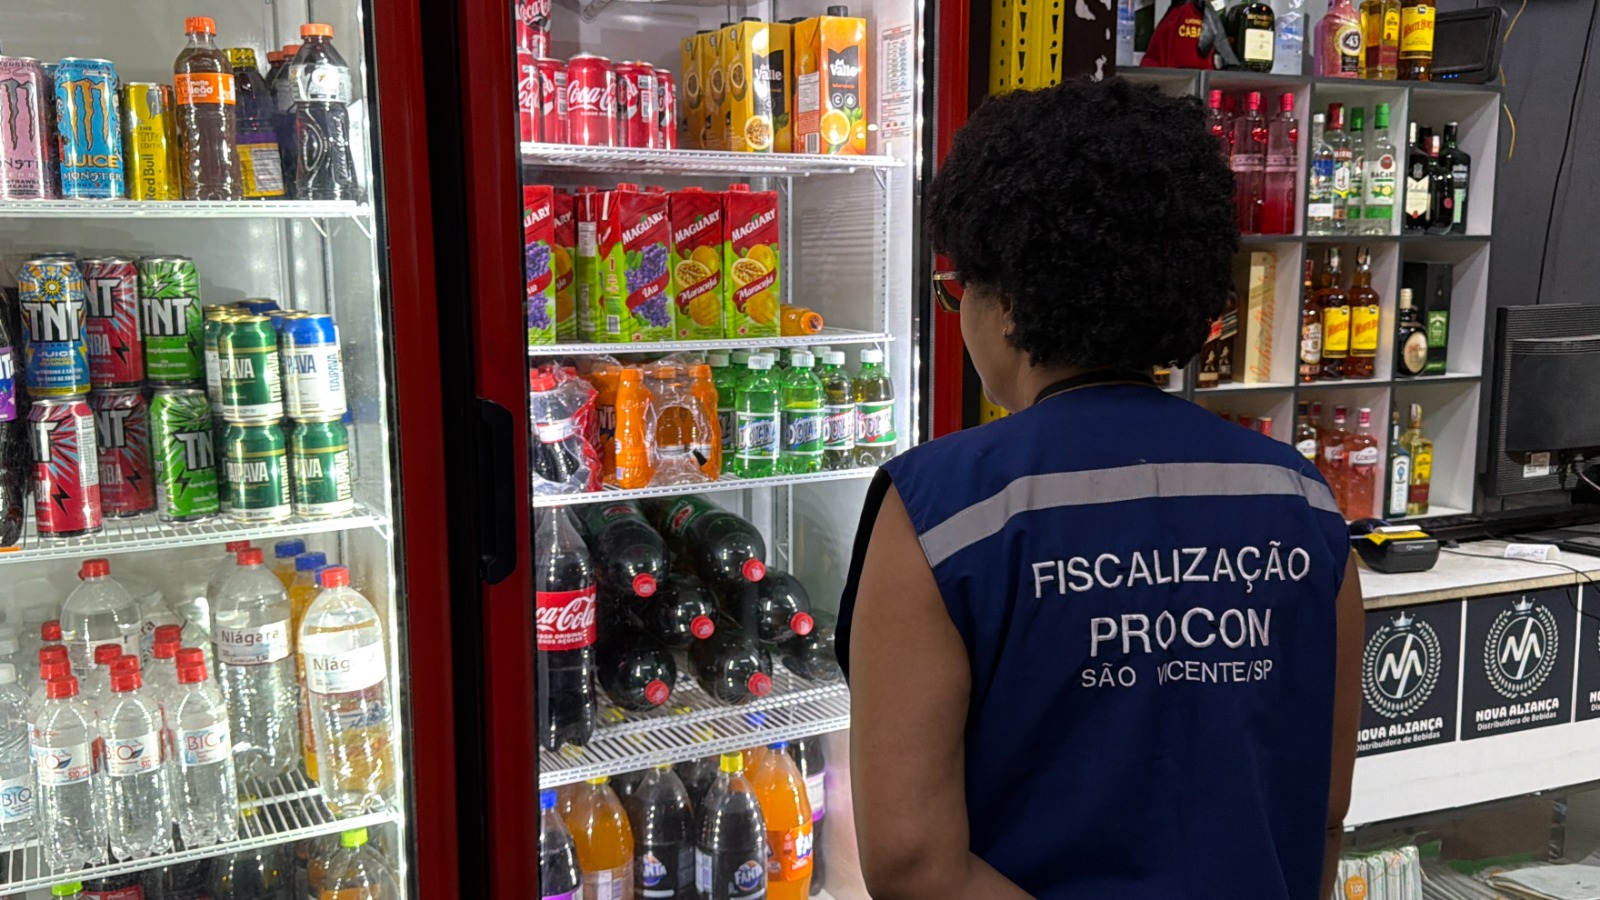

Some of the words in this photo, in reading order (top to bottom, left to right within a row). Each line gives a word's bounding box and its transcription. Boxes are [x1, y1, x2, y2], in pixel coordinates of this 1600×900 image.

[1346, 34, 1359, 47] 43
[754, 68, 782, 80] Valle
[829, 63, 858, 76] Valle
[65, 154, 119, 168] JUICE
[142, 154, 155, 176] Bull
[675, 209, 720, 244] MAGUARY
[731, 208, 776, 243] MAGUARY
[22, 301, 83, 341] TNT
[327, 353, 341, 392] ITAIPAVA
[1031, 540, 1311, 598] FISCALIZAÇÃO
[535, 593, 596, 631] ca-Cola
[221, 629, 279, 647] Niágara
[1090, 606, 1272, 657] PROCON
[1081, 662, 1136, 687] SÃO
[1157, 658, 1273, 685] VICENTE/SP
[1475, 706, 1507, 722] NOVA
[1509, 697, 1559, 716] ALIANÇA
[1477, 717, 1521, 731] Distribuidora
[1522, 714, 1531, 723] de
[1531, 711, 1557, 722] Bebidas
[1388, 716, 1443, 737] ALIANÇA
[1403, 735, 1412, 744] de
[1413, 731, 1440, 742] Bebidas
